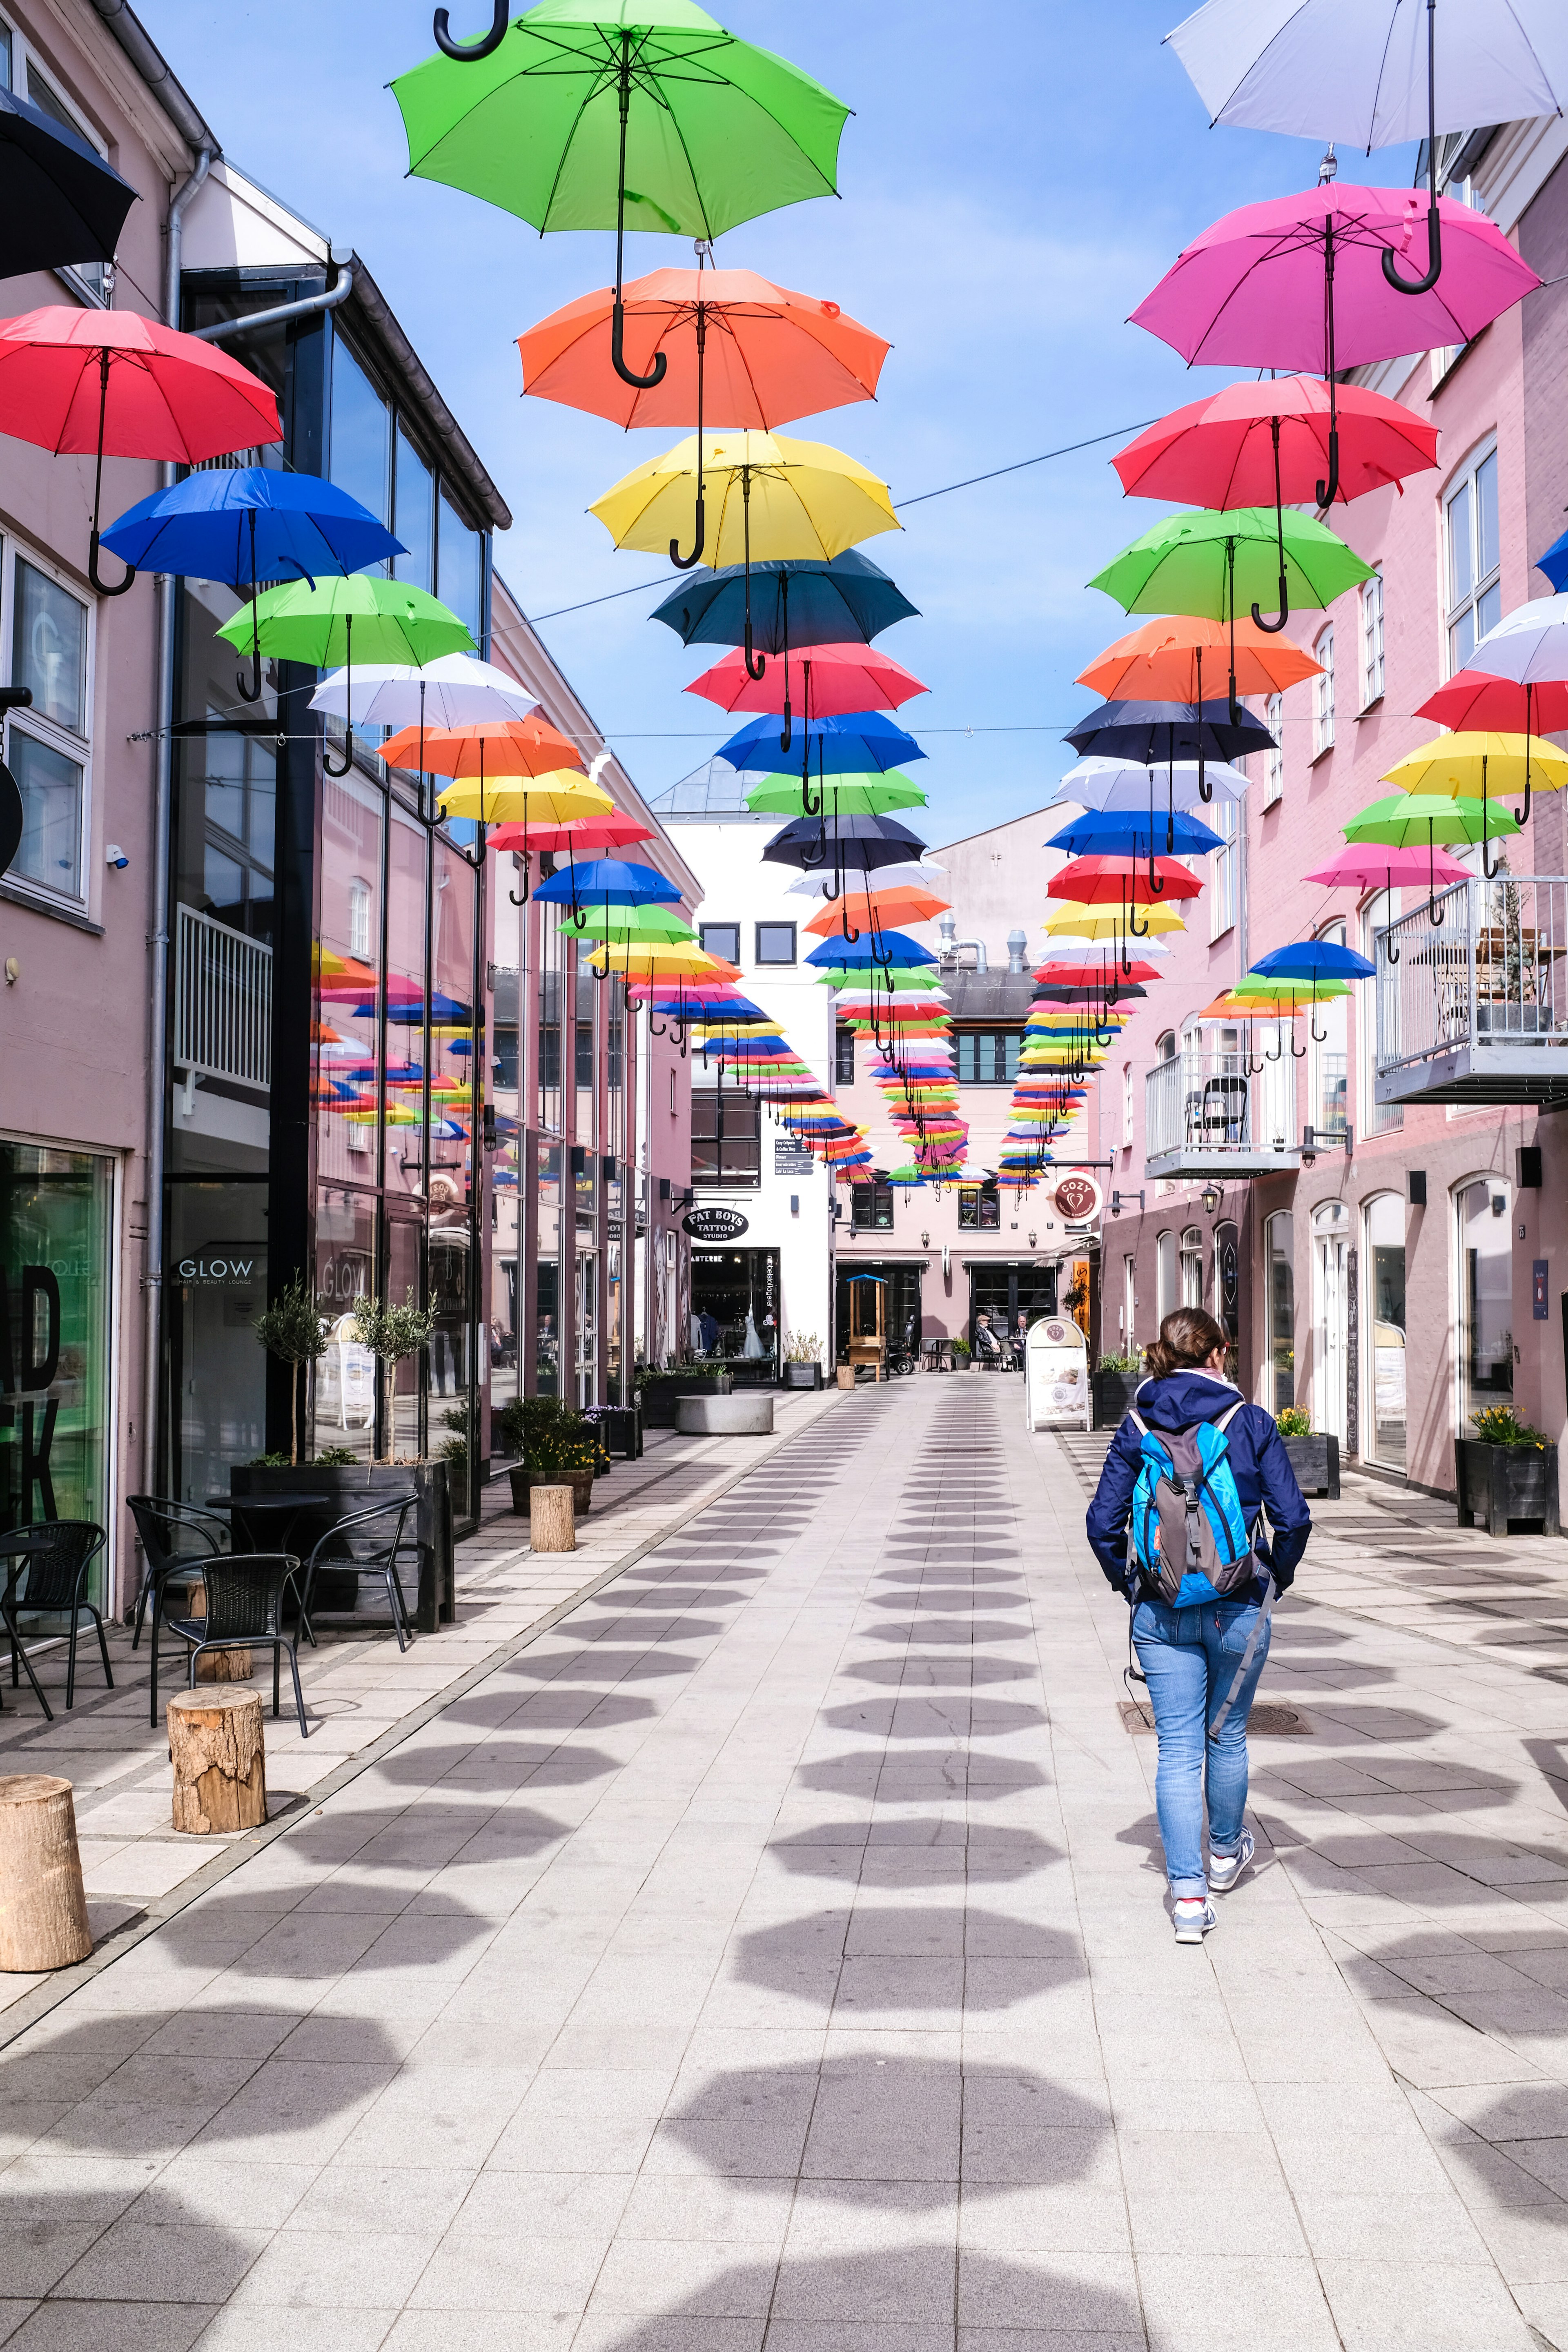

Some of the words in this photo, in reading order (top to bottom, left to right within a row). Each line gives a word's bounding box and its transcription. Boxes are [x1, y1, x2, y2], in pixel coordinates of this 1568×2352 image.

[1061, 1182, 1091, 1192] COZY
[1074, 1202, 1094, 1217] COFFEESHOP
[688, 1211, 711, 1225] FAT
[716, 1210, 744, 1226] BOYS
[1519, 1227, 1524, 1238] 75
[179, 1260, 253, 1278] GLOW
